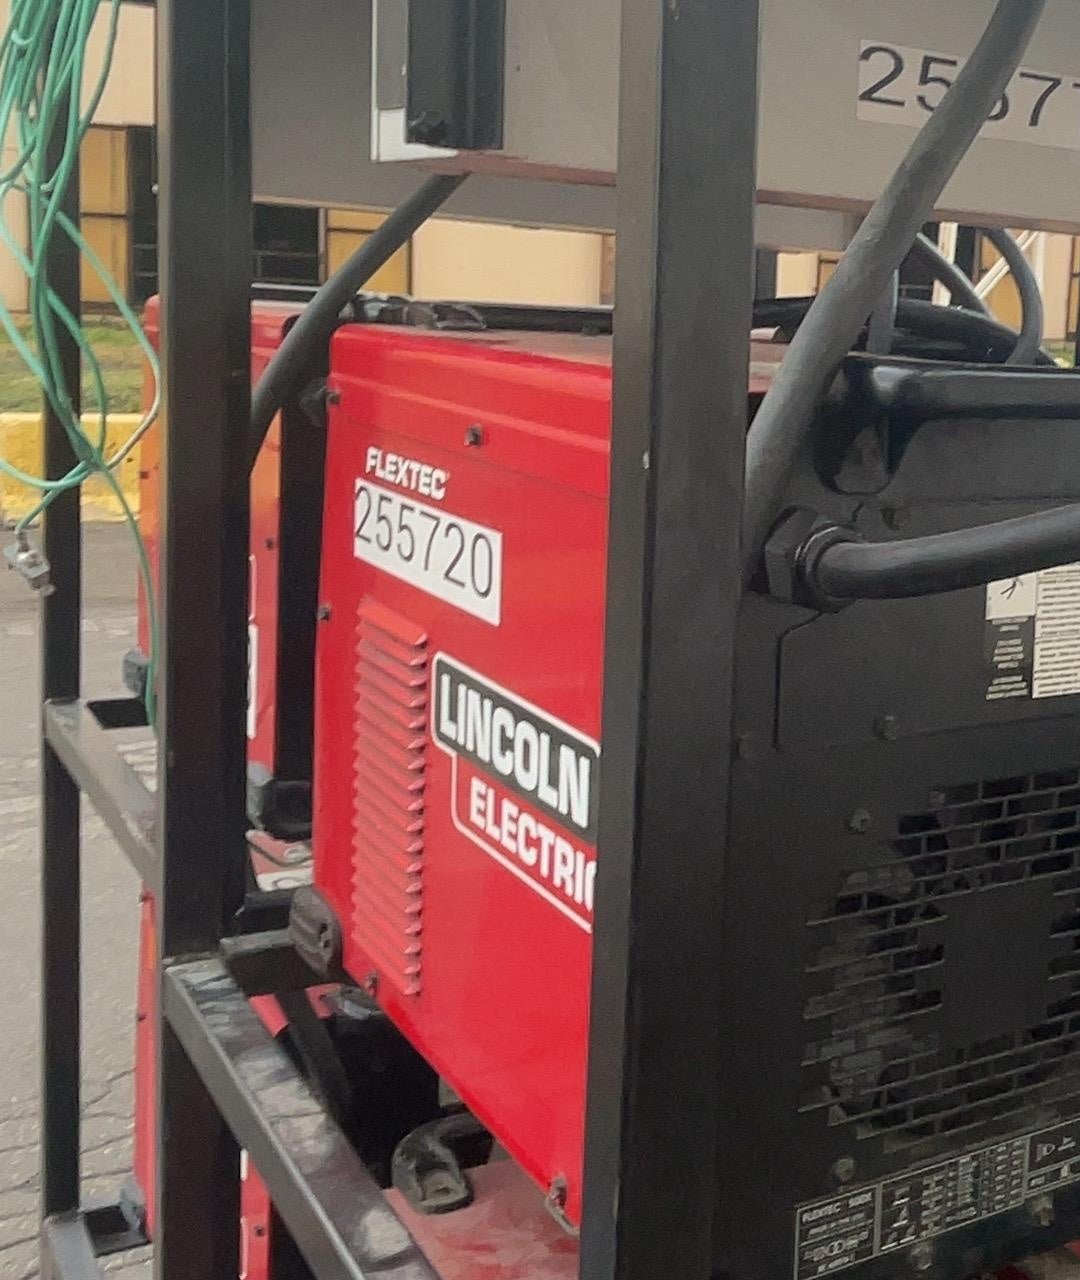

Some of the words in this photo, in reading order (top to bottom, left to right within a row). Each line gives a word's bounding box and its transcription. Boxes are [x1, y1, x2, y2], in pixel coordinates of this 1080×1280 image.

[365, 446, 448, 500] FLEXTEC
[355, 486, 494, 599] 255720
[439, 672, 591, 829] LINCOLN
